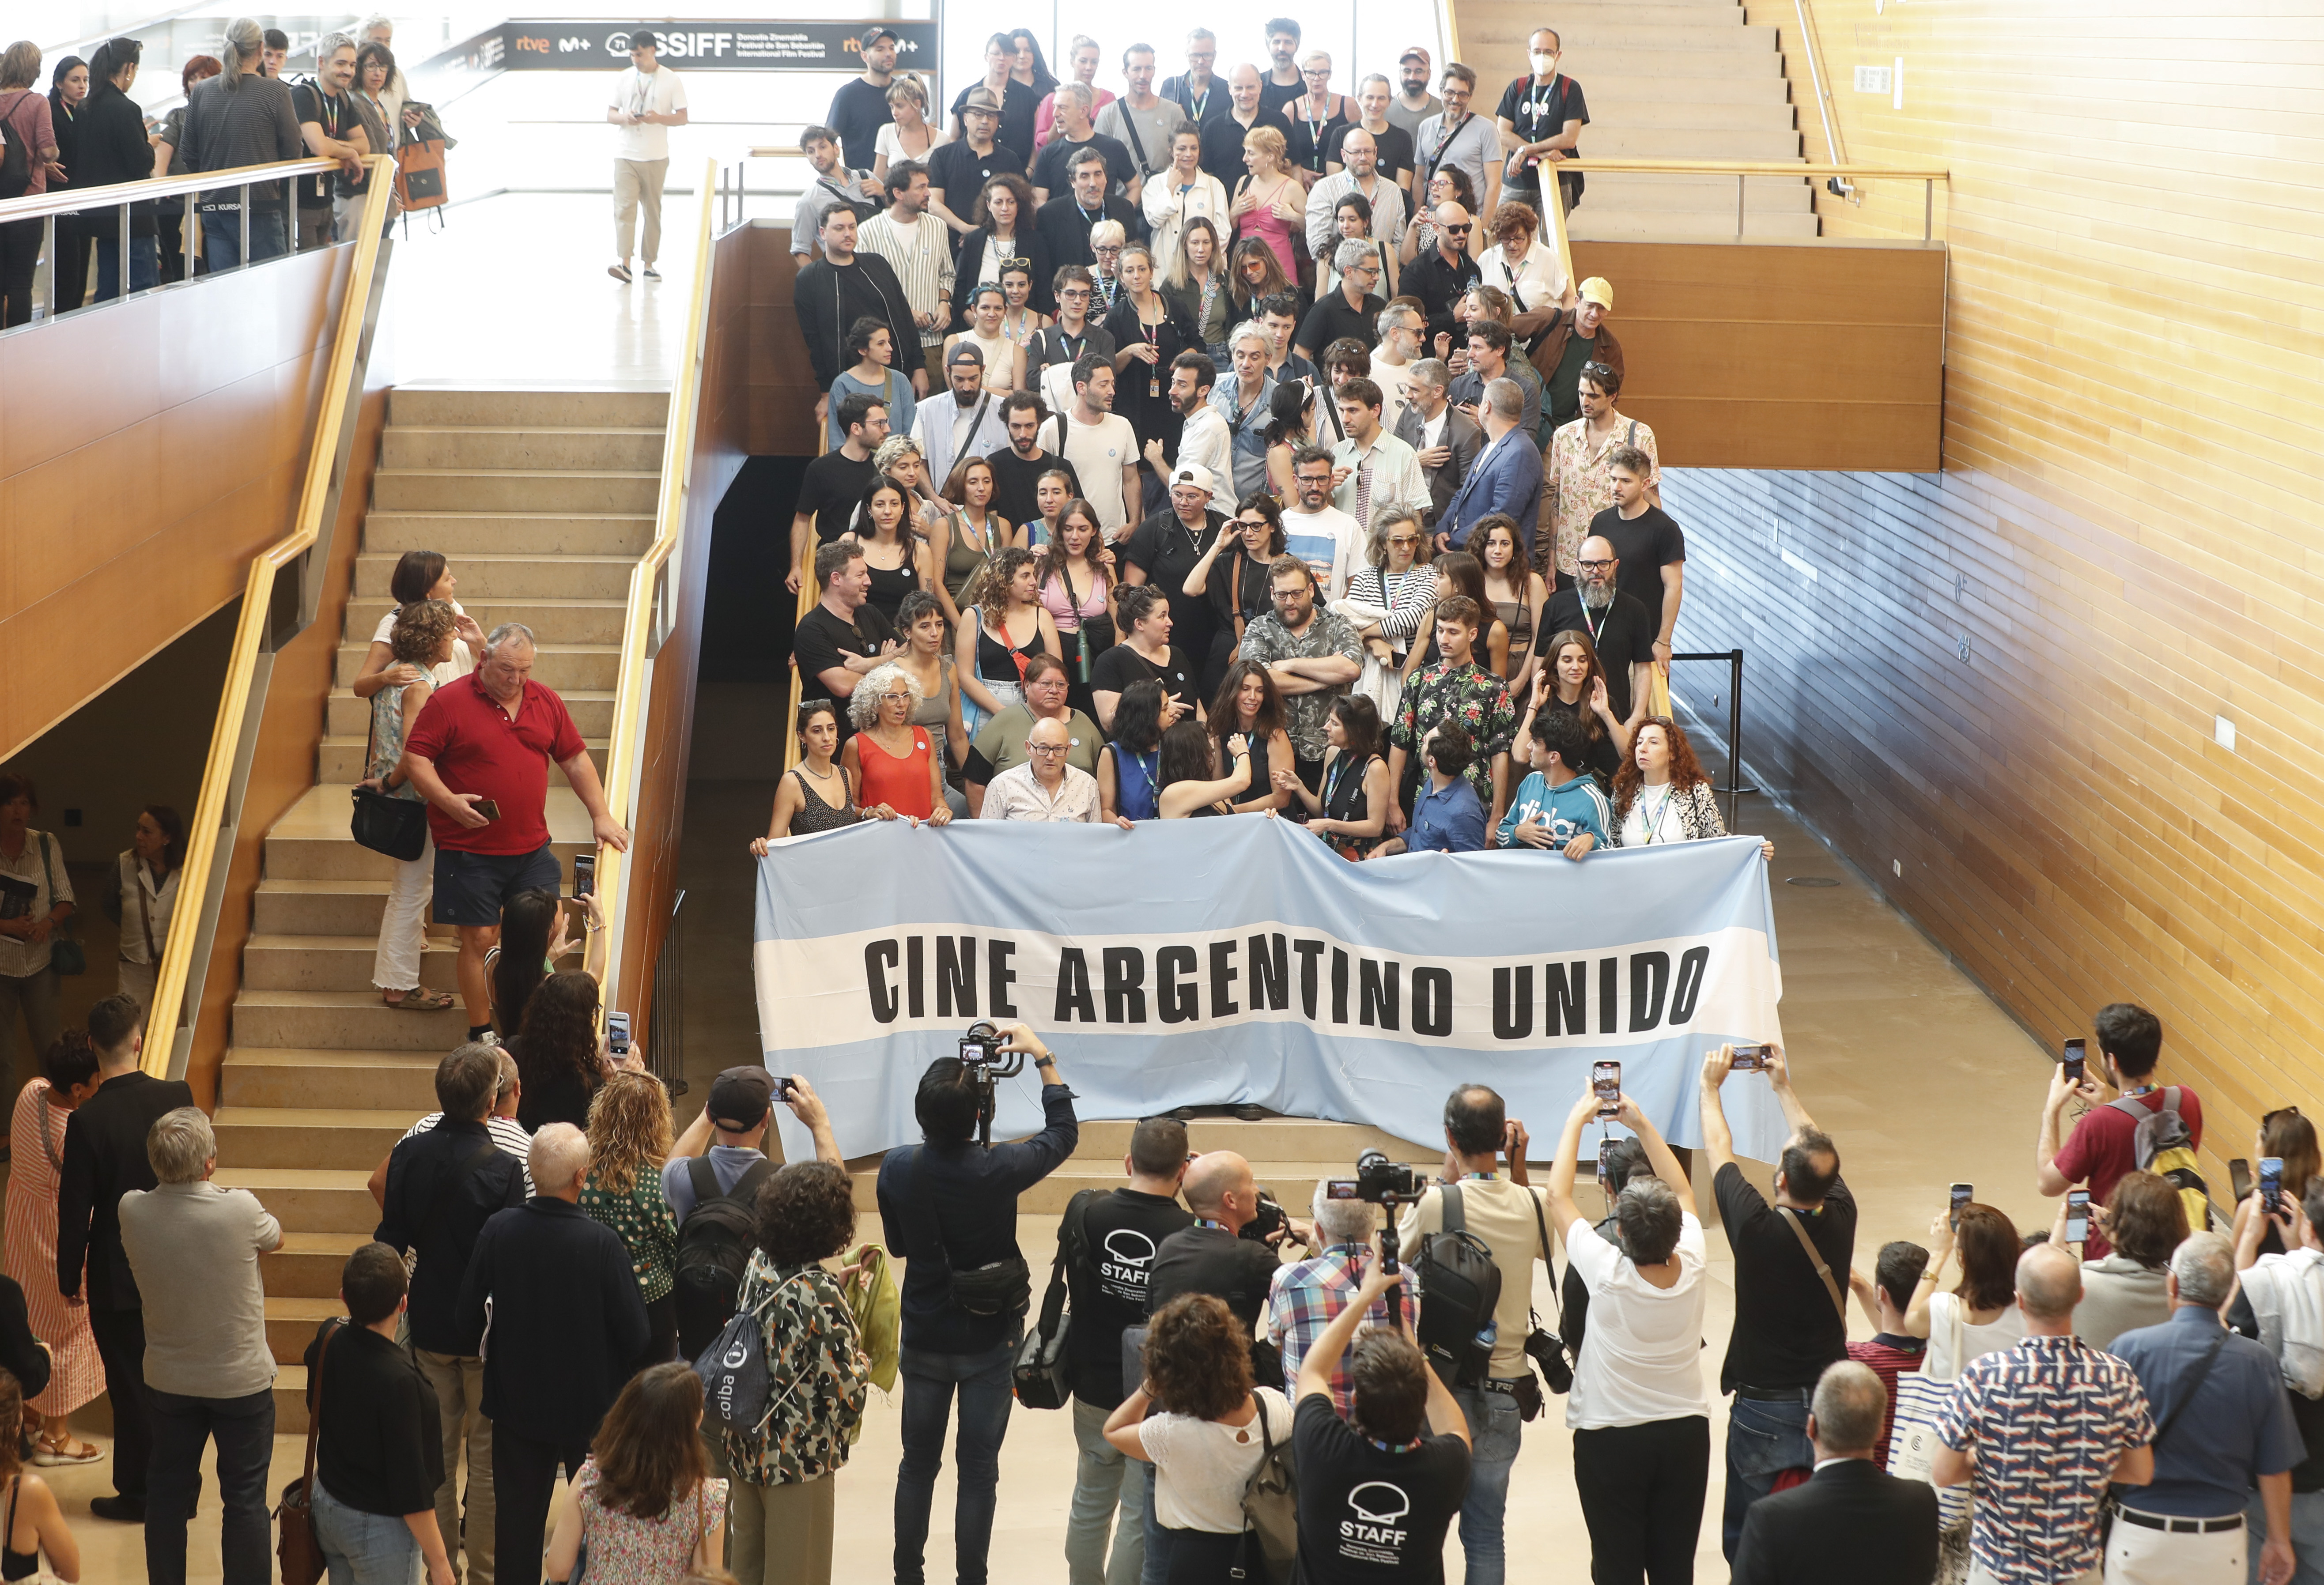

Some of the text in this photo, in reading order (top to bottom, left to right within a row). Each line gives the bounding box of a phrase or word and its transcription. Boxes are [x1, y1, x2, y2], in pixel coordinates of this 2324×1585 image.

[516, 35, 550, 54] rtve
[736, 32, 809, 41] Donostia Zinemaldia
[736, 41, 764, 49] Festival
[775, 41, 790, 49] San
[736, 49, 825, 58] International Film Festival
[864, 932, 1709, 1040] CINE ARGENTINO UNIDO
[718, 1374, 735, 1420] coiba
[1339, 1520, 1407, 1546] STAFF
